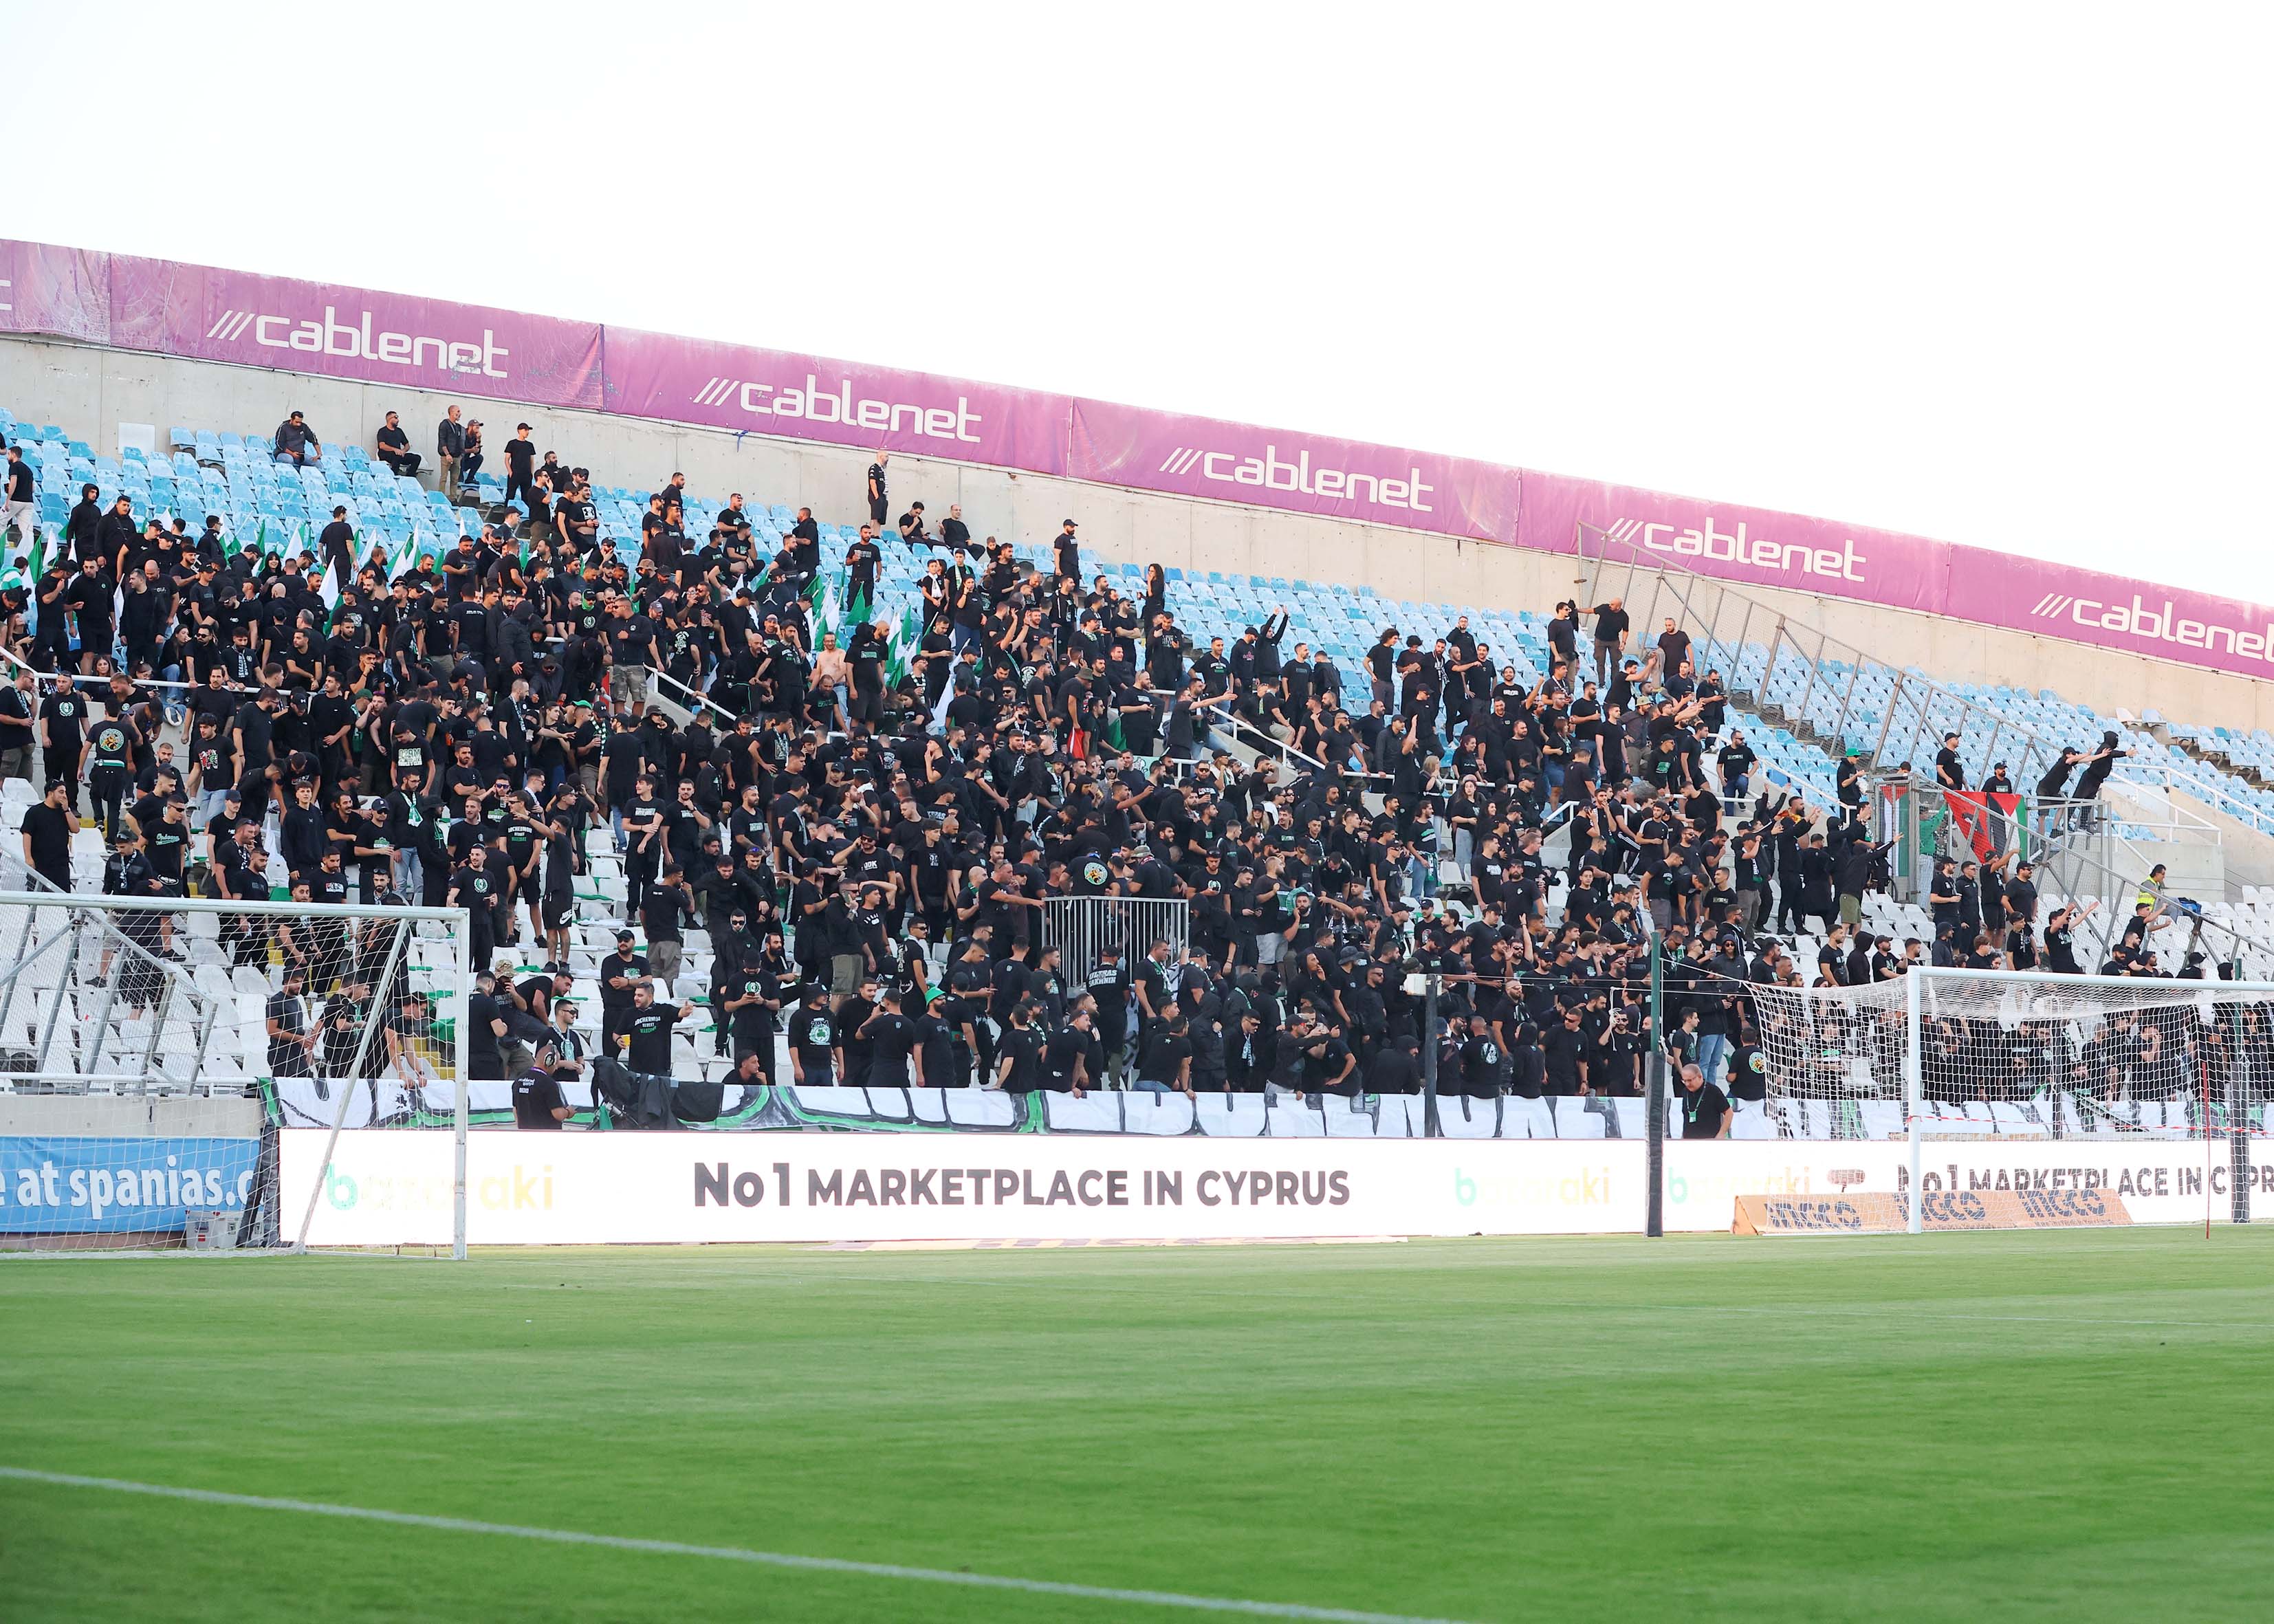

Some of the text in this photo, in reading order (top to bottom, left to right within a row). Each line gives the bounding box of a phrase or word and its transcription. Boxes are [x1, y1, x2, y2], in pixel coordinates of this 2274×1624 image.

[255, 306, 510, 380] cablenet
[740, 374, 982, 443] cablenet
[1203, 445, 1434, 512] cablenet
[1644, 517, 1867, 582] cablenet
[1089, 969, 1117, 980] ULTRAS
[1089, 976, 1117, 987] SAKHNIN
[17, 1160, 61, 1207] at
[69, 1155, 264, 1220] spanias.c
[695, 1162, 1350, 1207] No1 MARKETPLACE IN CYPRUS
[2178, 1167, 2202, 1196] IN
[2211, 1165, 2274, 1195] CPR
